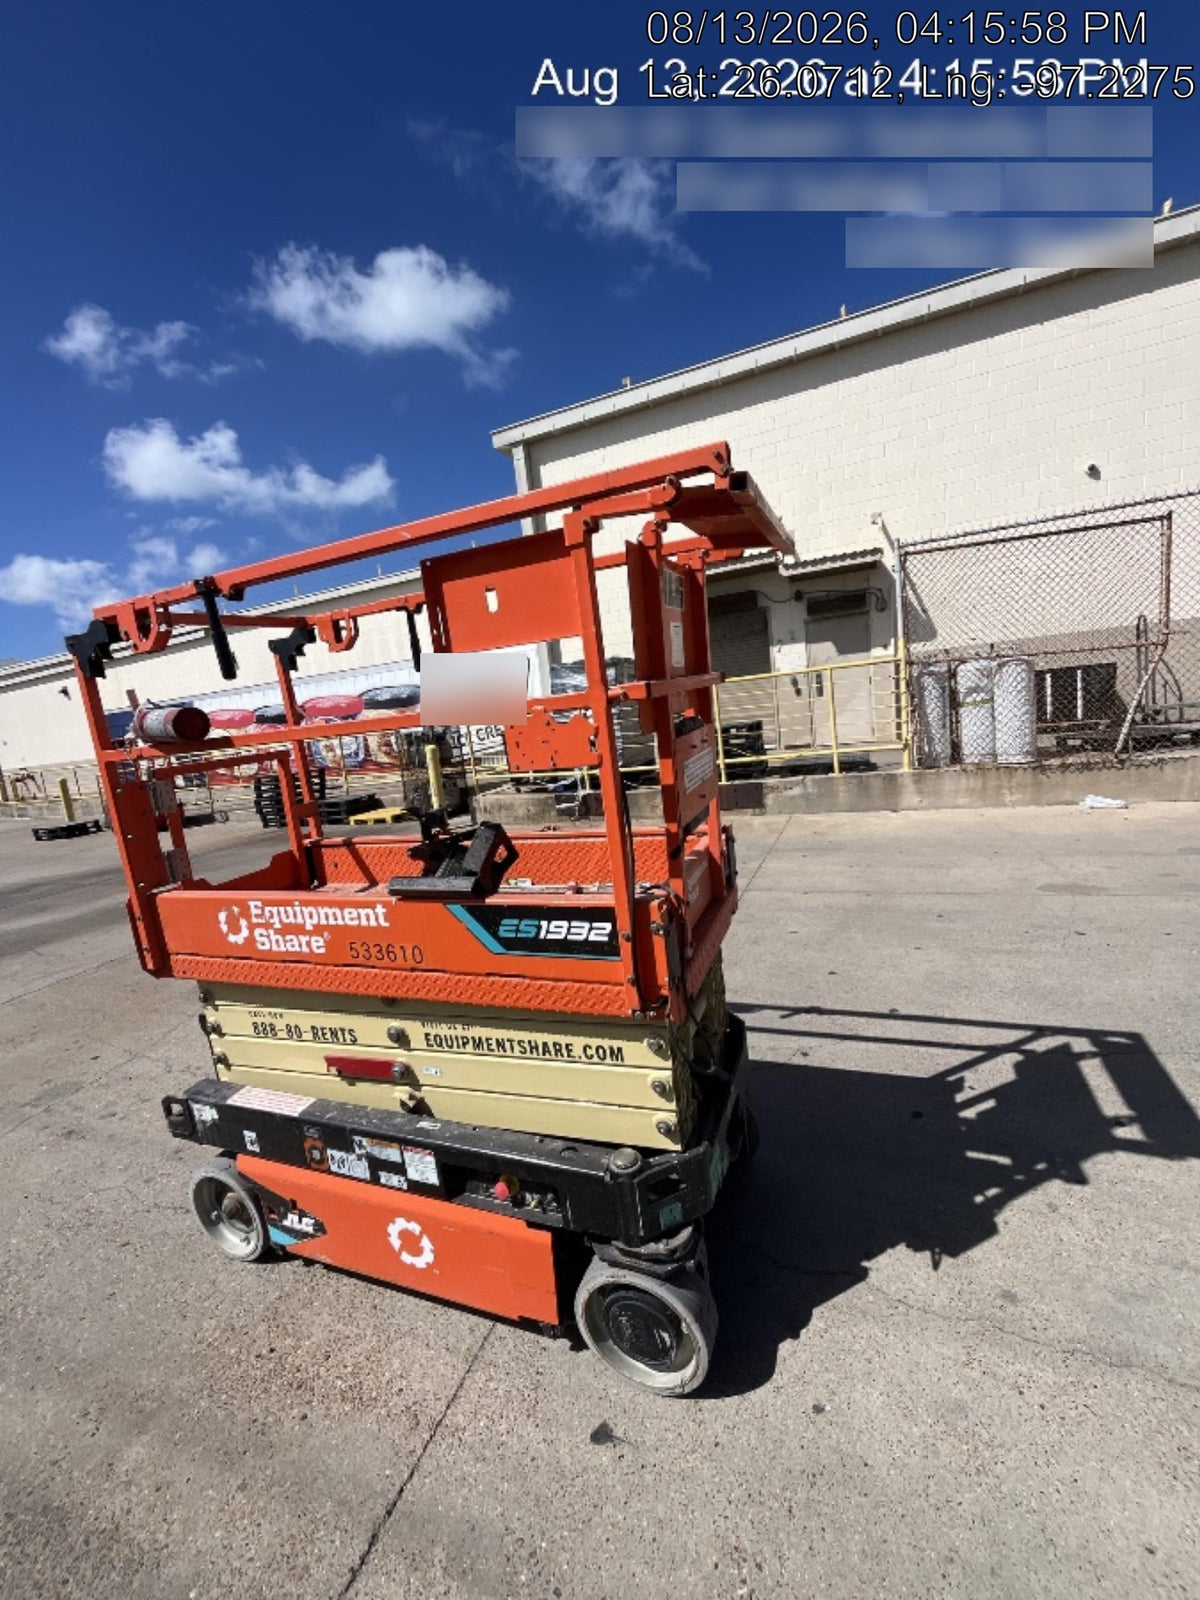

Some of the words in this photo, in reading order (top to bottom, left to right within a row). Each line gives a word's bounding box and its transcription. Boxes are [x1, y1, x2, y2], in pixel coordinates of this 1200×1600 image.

[248, 900, 390, 930] Equipment
[498, 918, 613, 942] ES1932
[349, 941, 424, 965] 533610
[252, 1021, 358, 1044] 888-80-RENTS
[424, 1032, 625, 1063] EQUIPMENTSHARE.COM
